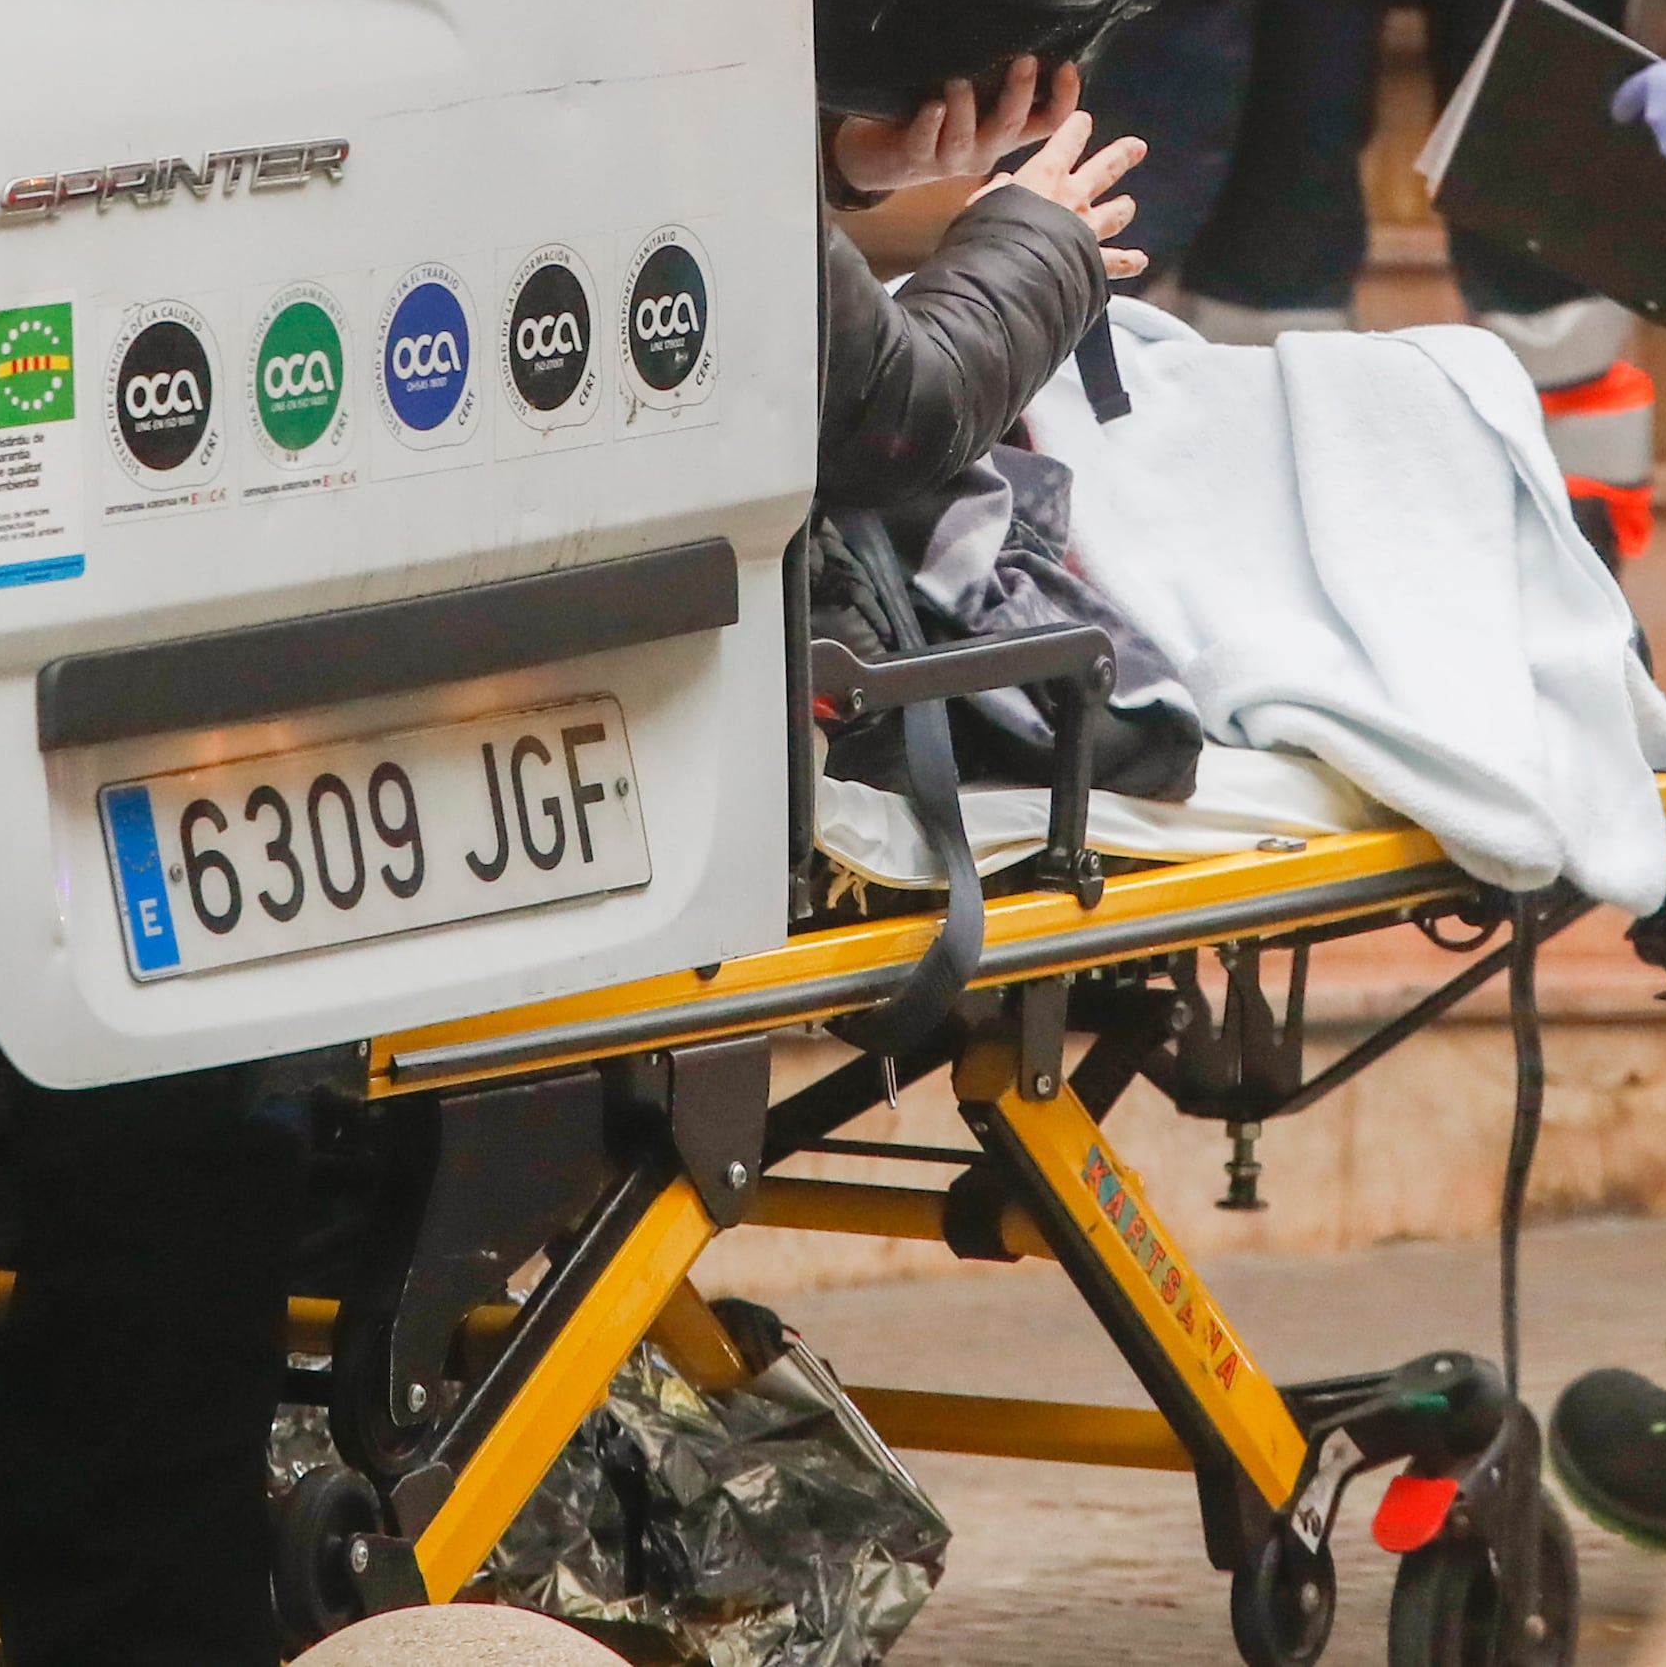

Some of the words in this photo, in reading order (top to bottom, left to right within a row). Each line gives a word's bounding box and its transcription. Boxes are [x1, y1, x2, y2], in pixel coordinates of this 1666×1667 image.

[695, 350, 713, 386] CERT
[579, 370, 597, 406] CERT
[457, 389, 476, 427] CERT
[331, 410, 350, 446] CERT
[199, 429, 220, 466] CERT
[179, 761, 426, 935] 6309
[465, 722, 607, 882] JGF
[139, 898, 164, 937] E
